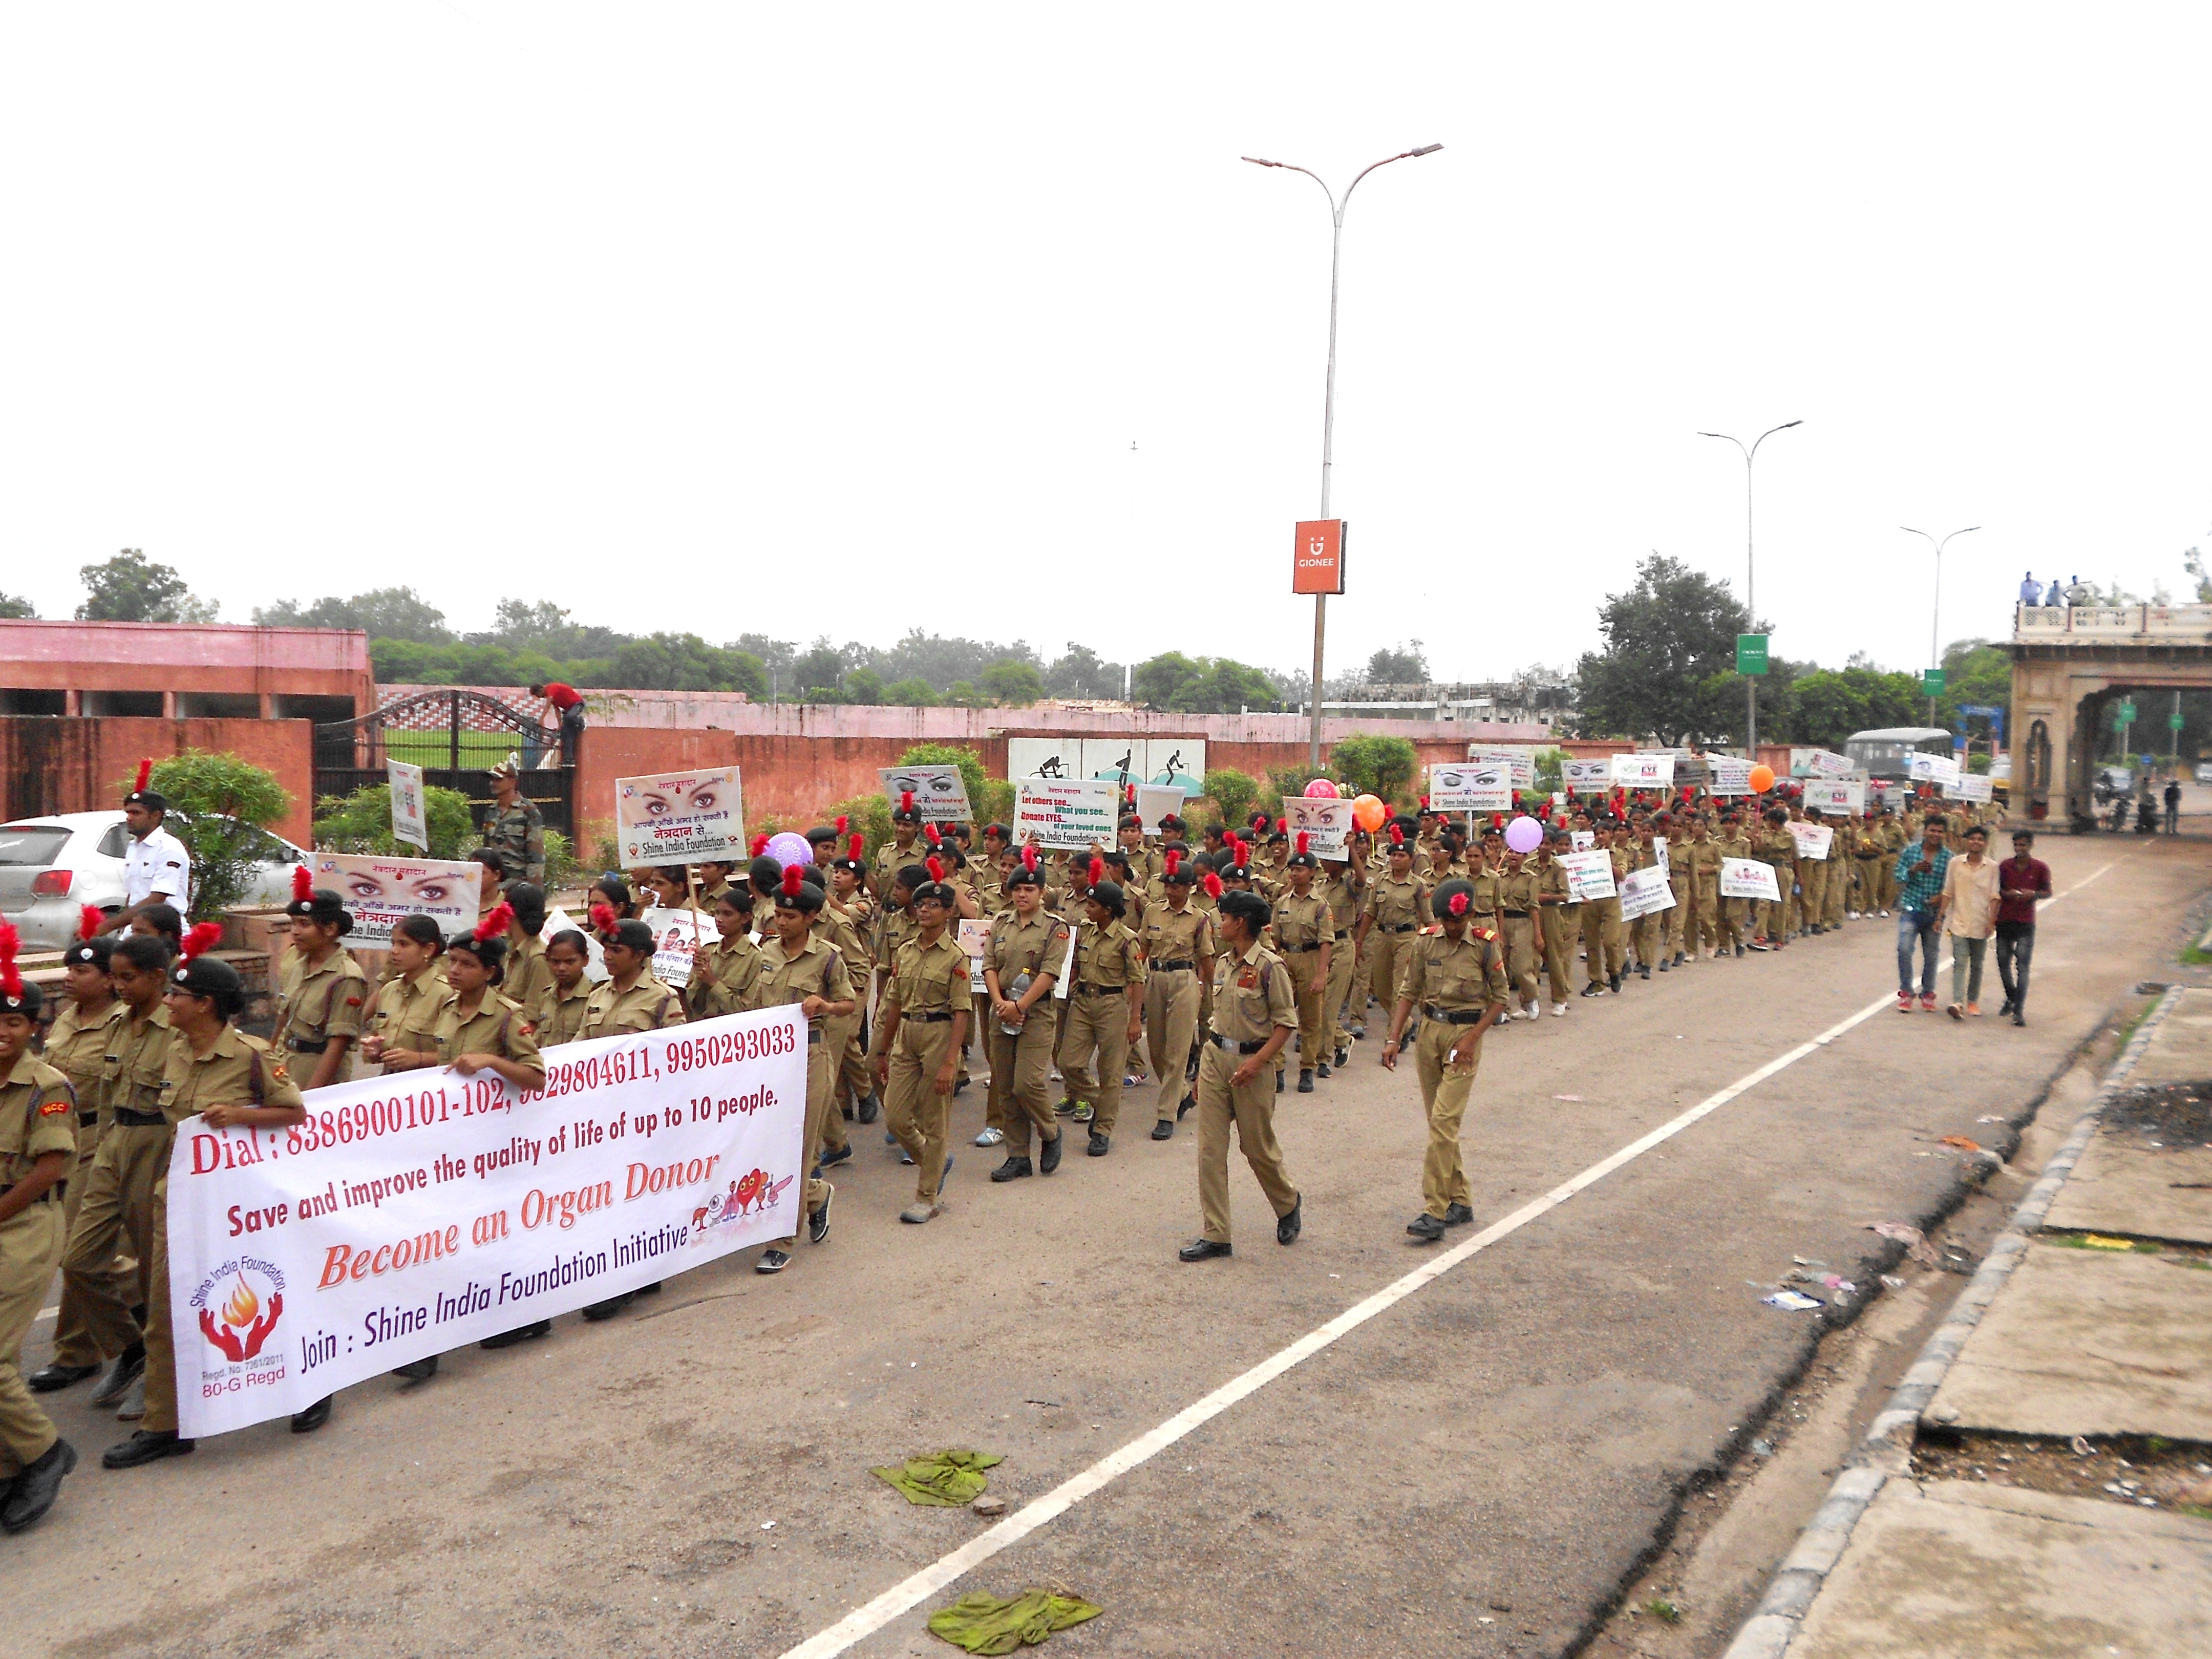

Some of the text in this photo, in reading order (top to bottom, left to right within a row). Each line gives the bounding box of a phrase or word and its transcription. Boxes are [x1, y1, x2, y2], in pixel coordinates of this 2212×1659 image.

[1299, 558, 1334, 567] GIONEE
[1032, 797, 1053, 806] others
[1021, 812, 1045, 821] Donate
[1055, 806, 1073, 814] What
[634, 819, 655, 829] आपकी
[693, 814, 700, 823] हो
[702, 811, 721, 821] सकती
[722, 810, 729, 819] है
[653, 826, 692, 839] नेत्रदान
[1047, 830, 1061, 840] India
[1064, 832, 1098, 843] Foundation
[642, 841, 664, 855] Shine
[665, 839, 685, 852] India
[686, 835, 726, 849] Foundation
[413, 904, 422, 912] हो
[425, 906, 452, 915] सकती
[454, 907, 461, 917] है
[971, 971, 983, 982] Shin
[191, 1125, 263, 1175] Dial
[286, 1077, 511, 1156] 8386900101-102,
[666, 1023, 795, 1074] 9950293033
[44, 1103, 65, 1113] NCC
[227, 1084, 778, 1237] Save and improve the quality of life of up to 10 people.
[316, 1153, 720, 1291] Become an Organ Donor
[190, 1256, 286, 1307] Shine India Foundation
[301, 1330, 337, 1374] Join
[364, 1306, 428, 1348] Shine
[435, 1281, 491, 1325] India
[499, 1252, 607, 1305] Foundation
[614, 1223, 688, 1269] Initiative
[202, 1369, 226, 1381] Regd.
[229, 1365, 243, 1375] No.
[202, 1366, 285, 1398] 80-G Regd
